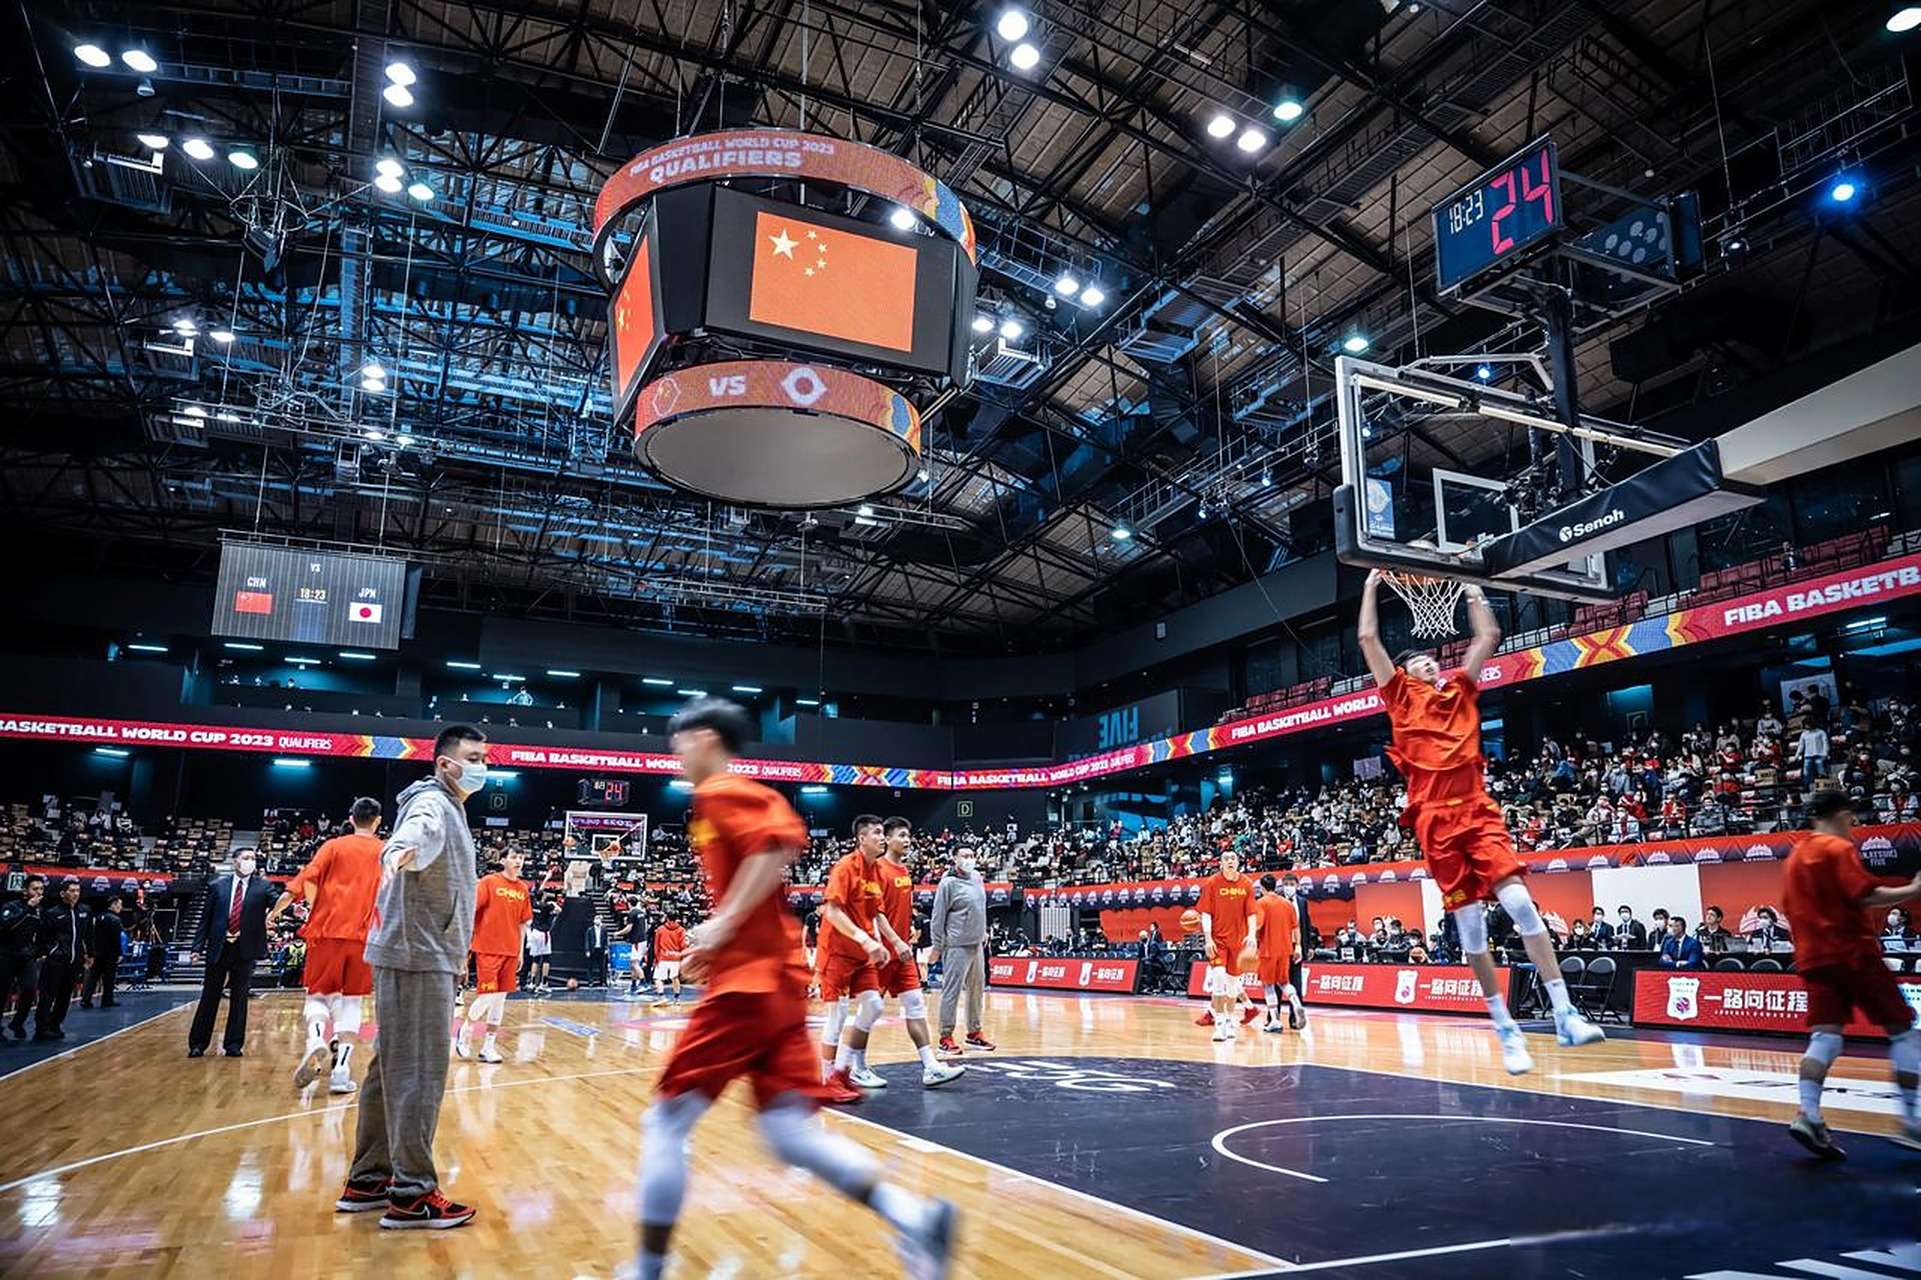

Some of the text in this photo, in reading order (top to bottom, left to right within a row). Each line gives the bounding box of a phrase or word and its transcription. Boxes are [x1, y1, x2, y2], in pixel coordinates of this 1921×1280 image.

[651, 141, 722, 167] BASKETBALL
[725, 138, 769, 149] WORLD
[773, 138, 800, 149] CUP
[803, 140, 834, 154] 2023
[650, 150, 802, 185] QUALIFIERS
[1450, 189, 1484, 234] 18:23
[1491, 148, 1553, 254] 24
[709, 374, 746, 397] VS
[1573, 508, 1624, 539] Senoh
[247, 576, 267, 589] CHN
[299, 587, 326, 600] 18:23
[358, 587, 376, 599] JPN
[1724, 566, 1921, 626] FIBA BASKETB
[1231, 695, 1378, 740] FIBA BASKETBALL WORLD
[122, 727, 187, 742] WORLD
[190, 730, 227, 744] CUP
[229, 733, 274, 746] 2023
[279, 736, 332, 750] QUALIFIERS
[511, 751, 802, 777] FIBA BASKETBALL WORL 2023 QUALIFIERS
[605, 782, 622, 800] 24
[937, 776, 966, 786] FIBA
[969, 772, 1048, 785] BASKETBALL
[1219, 887, 1247, 896] CHINA
[1704, 988, 1808, 1012] 一路向征程
